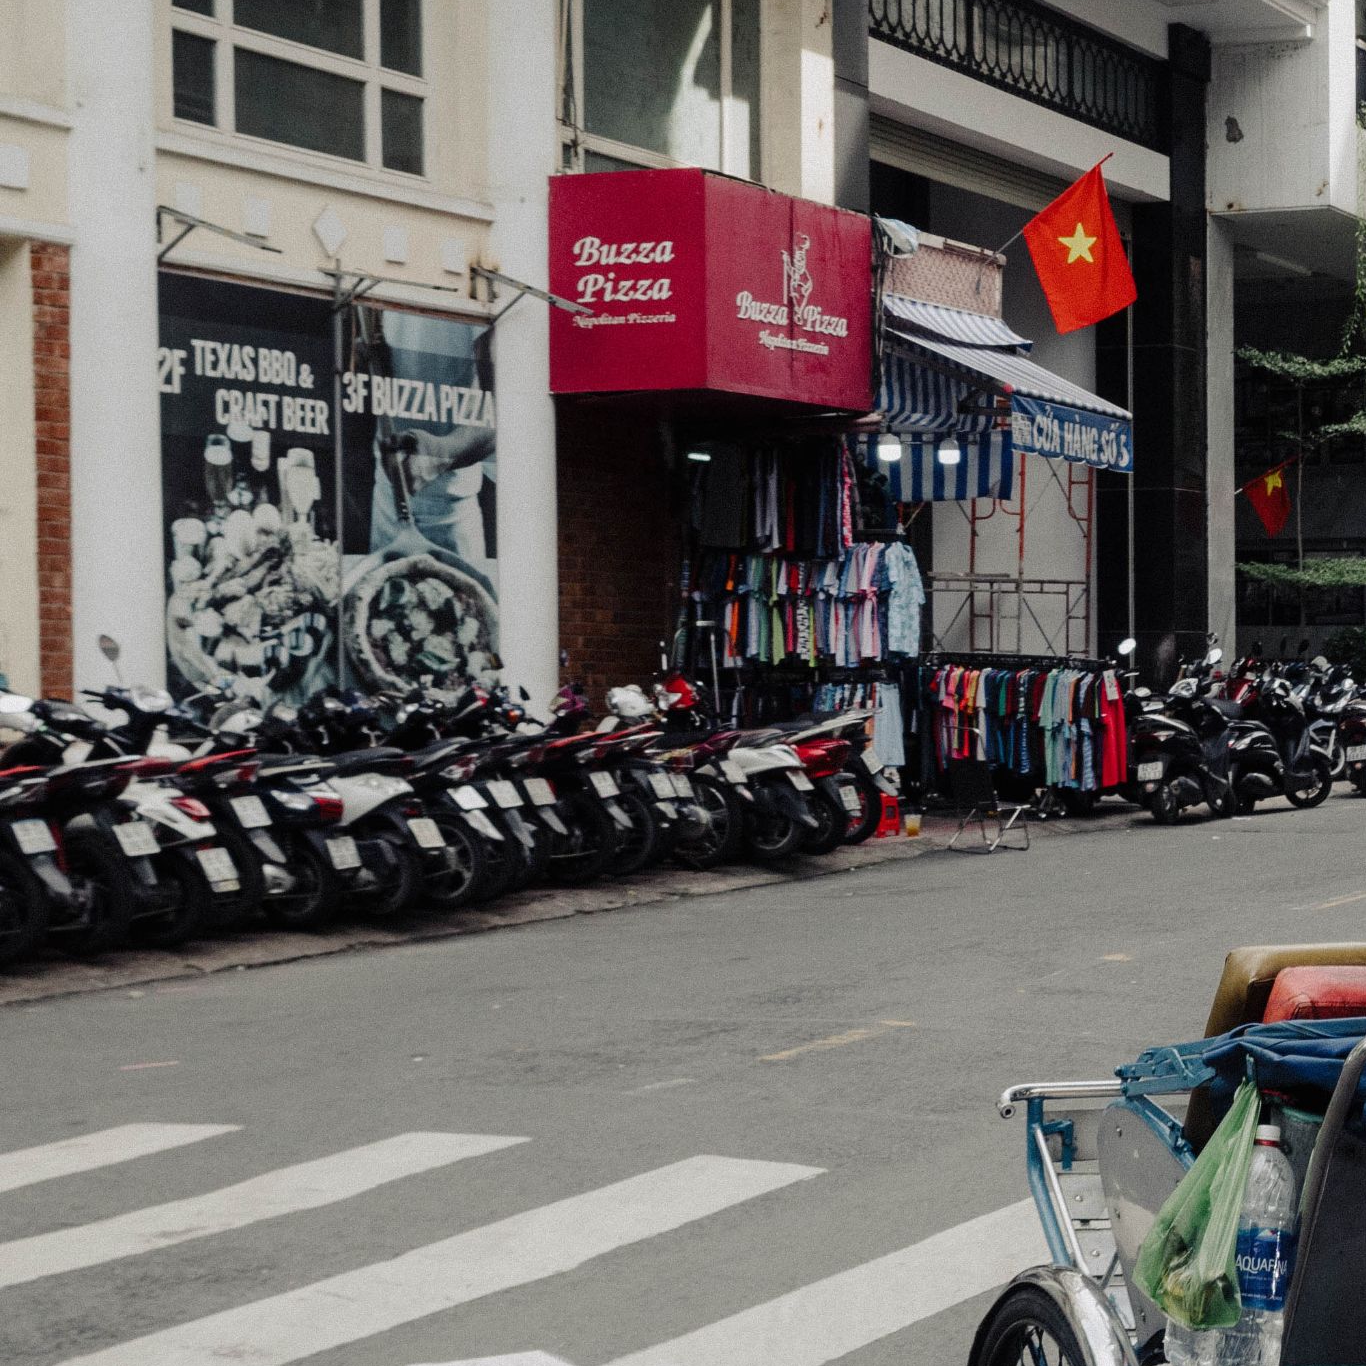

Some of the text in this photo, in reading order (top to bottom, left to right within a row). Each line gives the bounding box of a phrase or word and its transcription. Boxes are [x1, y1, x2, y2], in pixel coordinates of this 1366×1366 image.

[572, 236, 675, 266] Buzza
[577, 272, 673, 302] Pizza
[736, 291, 848, 338] Buzza Pizza
[190, 338, 256, 382] TEXAS
[258, 347, 297, 387] BBQ
[298, 363, 315, 389] &
[215, 388, 330, 435] CRAFT BEER
[342, 371, 495, 428] 3F BUZZA PIZZA
[1033, 404, 1060, 453] CỬA
[1063, 413, 1099, 462] HÀNG
[1100, 422, 1120, 465] SỐ
[1119, 434, 1130, 468] 5
